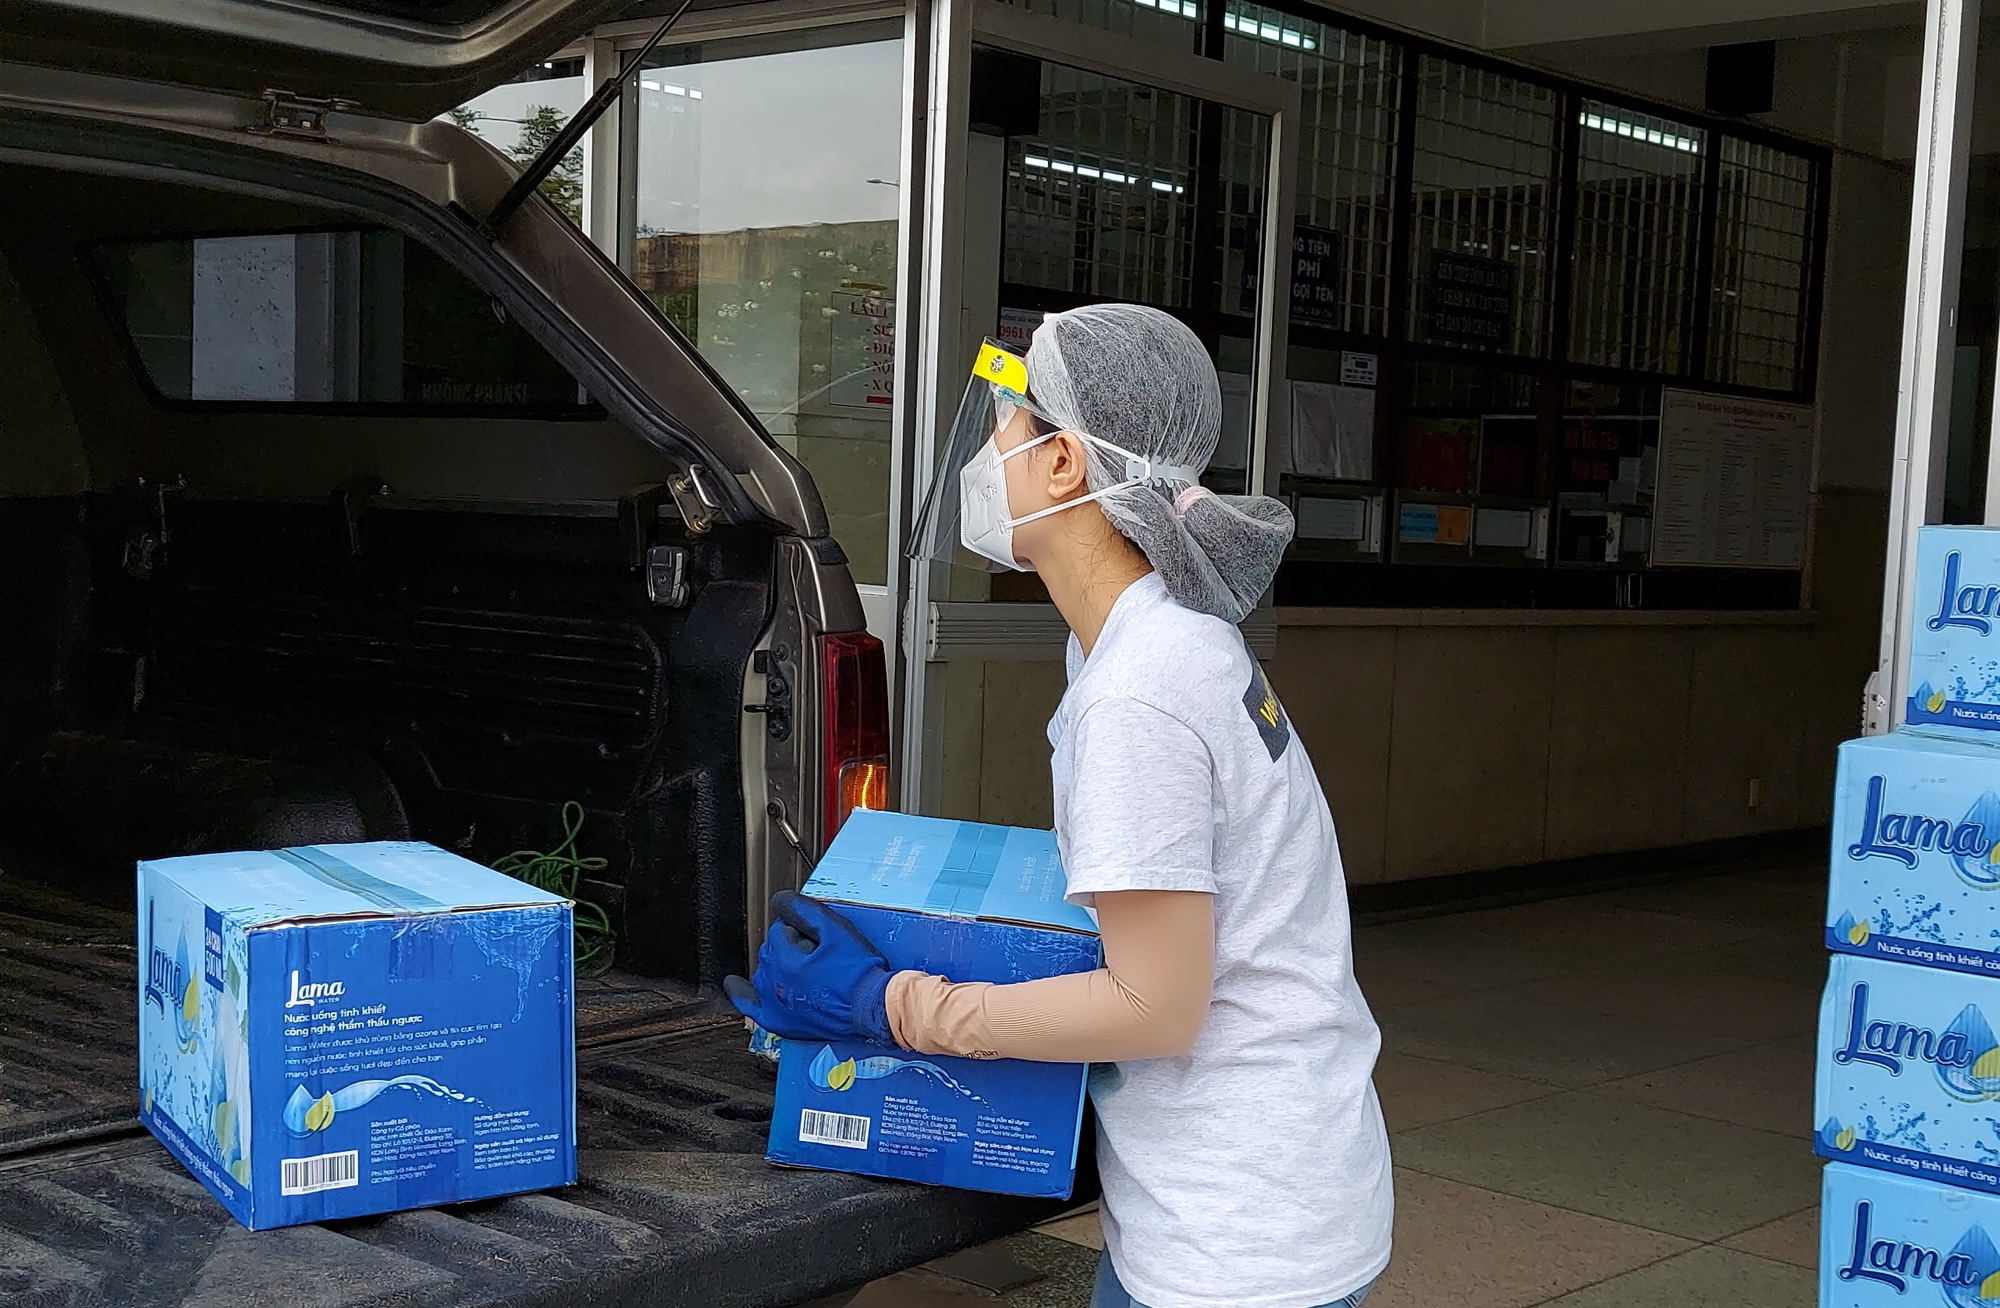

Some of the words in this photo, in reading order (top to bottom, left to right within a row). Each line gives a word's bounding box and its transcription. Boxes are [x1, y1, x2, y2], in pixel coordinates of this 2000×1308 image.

[1297, 257, 1321, 278] PHÍ
[1000, 324, 1024, 339] 0961
[1953, 707, 1978, 719] Nước
[1848, 774, 1990, 870] Lama
[144, 897, 182, 1020] Lama
[1877, 941, 1905, 955] Nước
[1907, 946, 1933, 961] uống
[1936, 951, 1955, 963] tinh
[1958, 954, 1983, 967] khiết
[285, 970, 345, 1008] Lama
[284, 1014, 310, 1023] Nước
[312, 1010, 337, 1022] uống
[340, 1008, 359, 1017] tinh
[362, 1003, 386, 1015] khiết
[284, 1028, 308, 1037] công
[311, 1023, 335, 1035] nghệ
[367, 1016, 389, 1027] thấu
[392, 1015, 423, 1026] ngược
[1833, 981, 1973, 1076] Lama
[1864, 1148, 1891, 1162] Nước
[1893, 1154, 1919, 1169] uống
[1921, 1160, 1941, 1172] tinh
[1943, 1163, 1969, 1177] khiết
[1971, 1171, 1997, 1185] công
[1837, 1199, 1979, 1295] Lama
